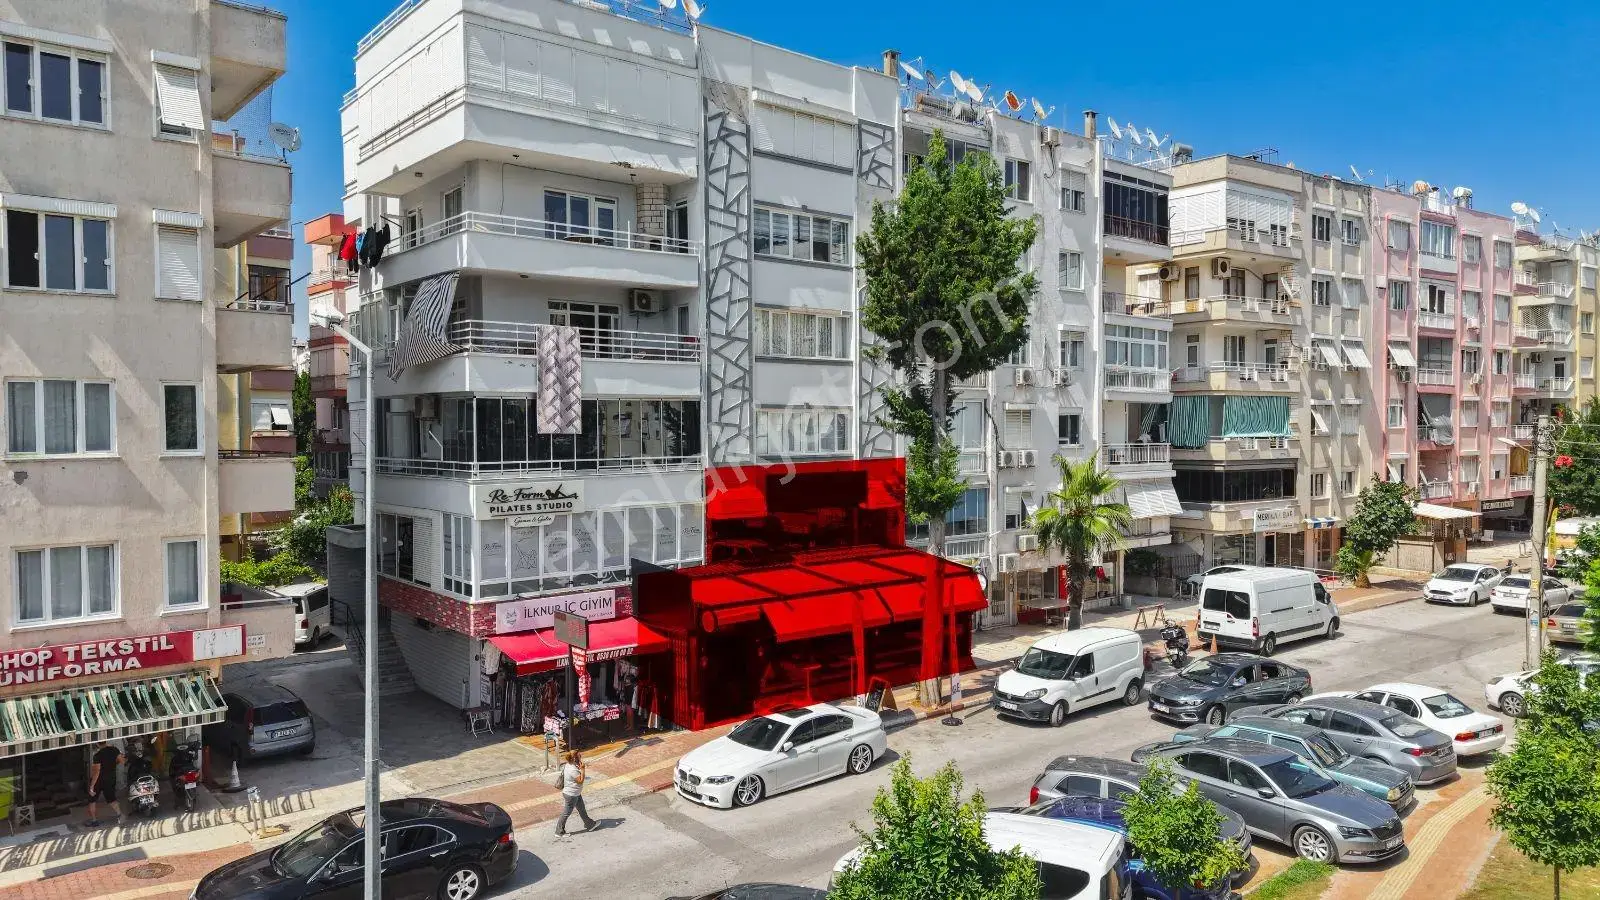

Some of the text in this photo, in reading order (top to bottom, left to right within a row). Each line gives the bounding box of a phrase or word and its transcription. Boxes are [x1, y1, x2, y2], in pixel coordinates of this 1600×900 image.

[486, 487, 545, 503] Re-Form
[490, 501, 573, 514] PILATES STUDIO
[524, 596, 612, 619] İLKNUR İÇ GİYİM
[63, 635, 175, 662] TEKSTİL
[0, 656, 142, 687] ÜNİFORMA
